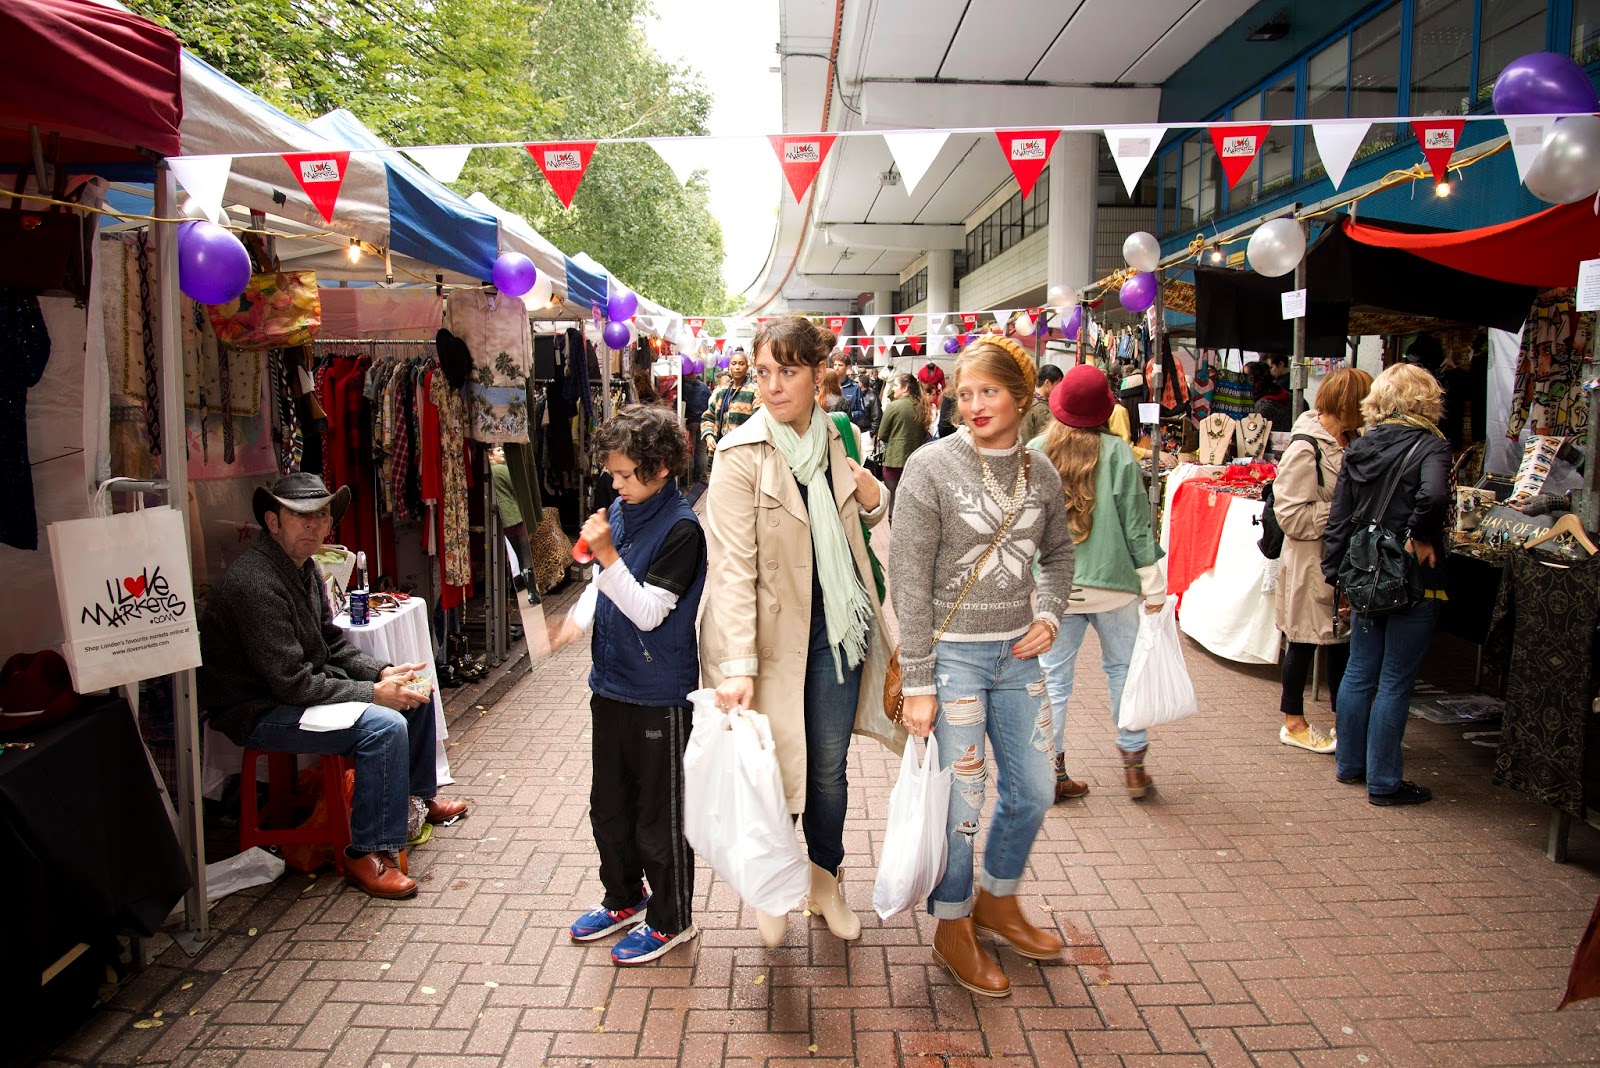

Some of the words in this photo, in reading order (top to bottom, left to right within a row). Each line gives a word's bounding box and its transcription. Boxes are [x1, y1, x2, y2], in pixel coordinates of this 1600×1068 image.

[1481, 515, 1511, 530] HAUS
[1512, 521, 1543, 535] OF
[81, 593, 186, 628] MARKeTS
[150, 613, 177, 624] .com
[84, 645, 100, 653] Shop
[100, 640, 125, 650] London's
[125, 635, 149, 645] favourite
[149, 631, 169, 640] markets
[169, 628, 185, 636] online
[111, 640, 170, 656] www.ilovemarkets.com
